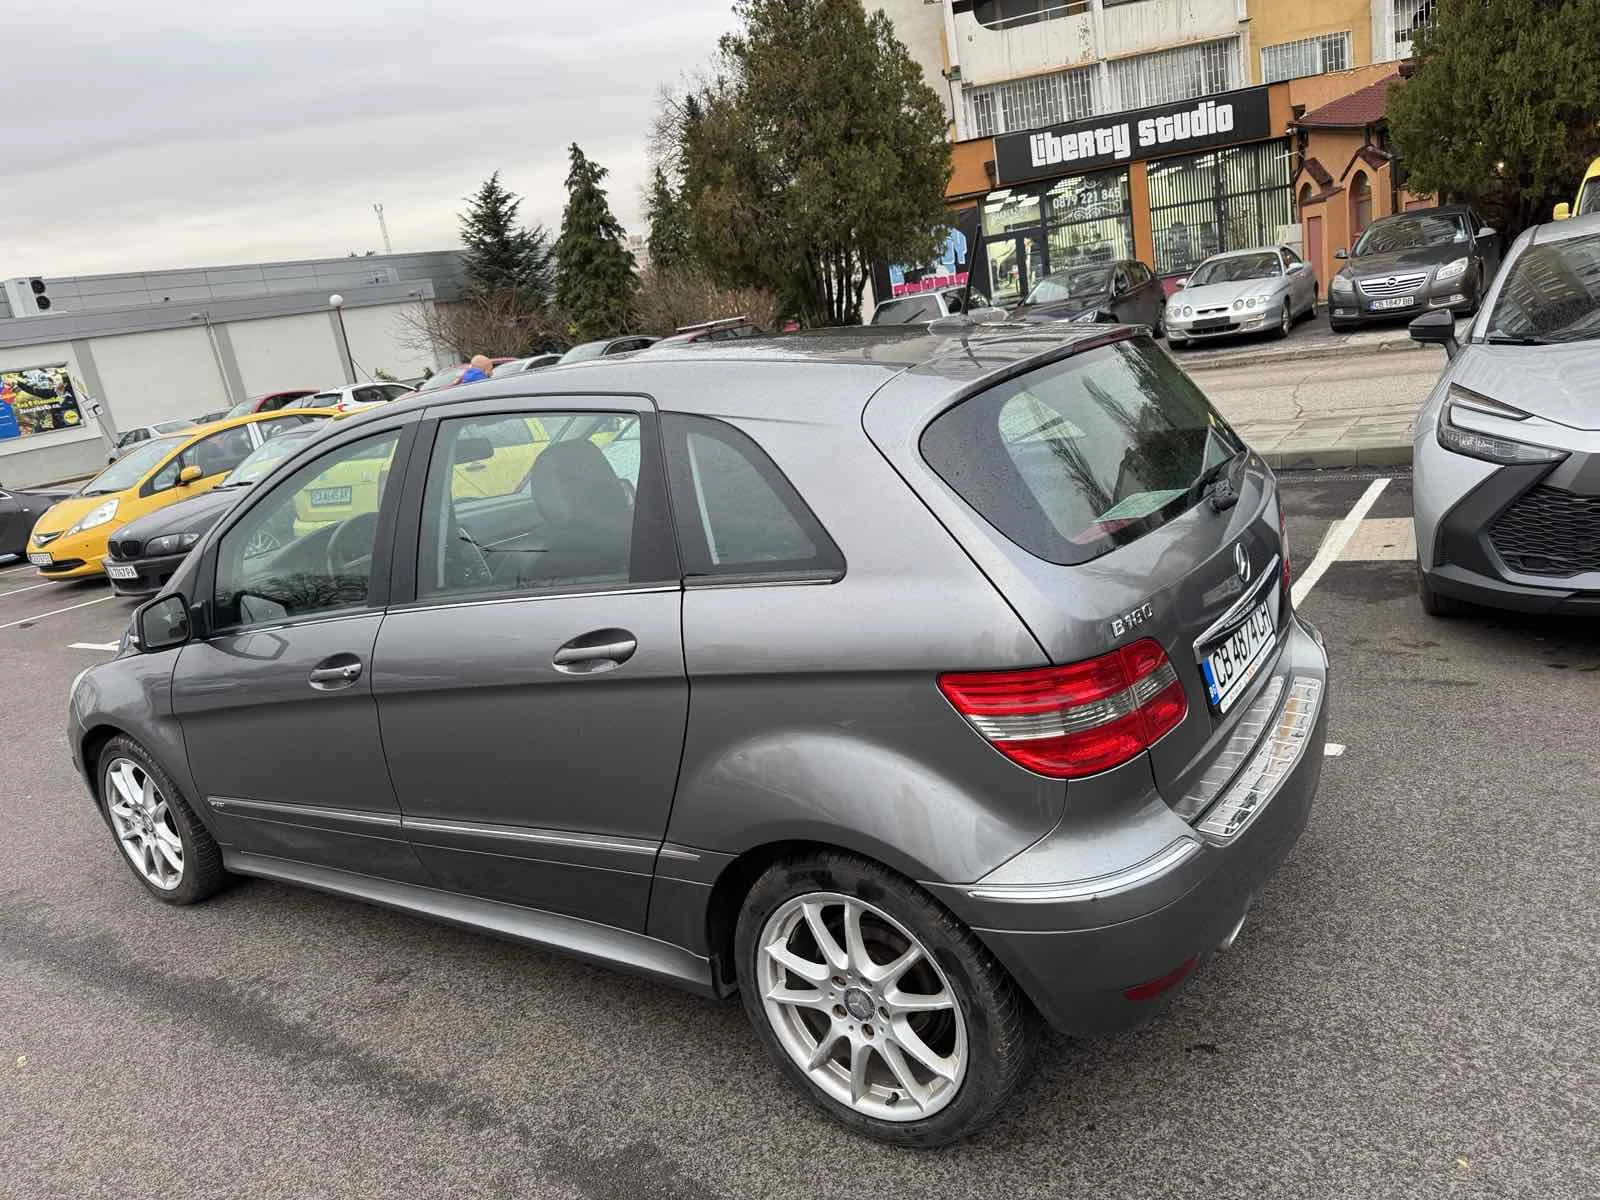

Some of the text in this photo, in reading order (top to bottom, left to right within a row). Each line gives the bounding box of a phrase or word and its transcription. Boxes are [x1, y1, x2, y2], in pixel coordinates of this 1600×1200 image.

[1080, 190, 1098, 204] 221
[1213, 645, 1233, 688] CB
[1232, 617, 1259, 666] 4874
